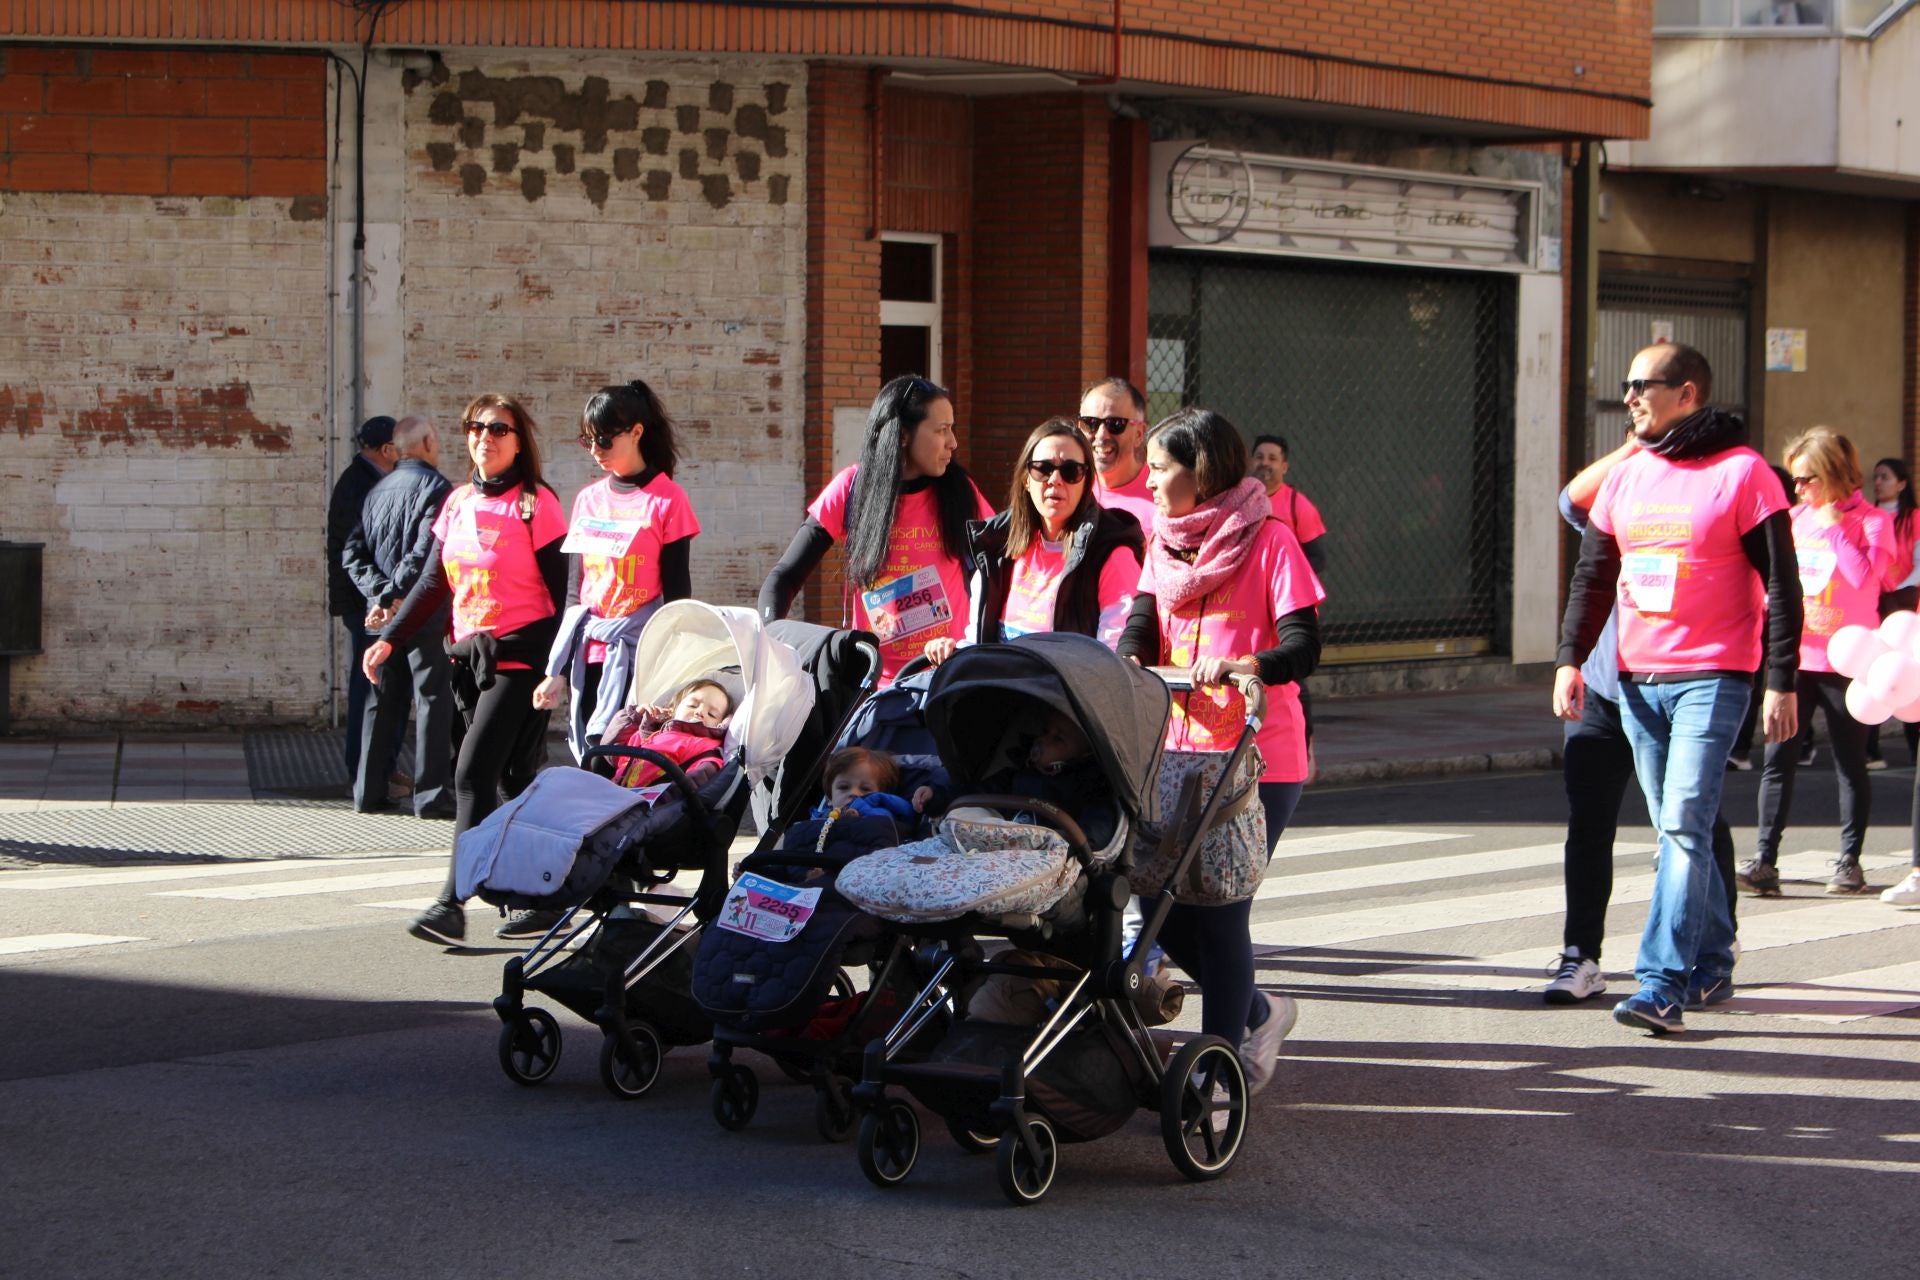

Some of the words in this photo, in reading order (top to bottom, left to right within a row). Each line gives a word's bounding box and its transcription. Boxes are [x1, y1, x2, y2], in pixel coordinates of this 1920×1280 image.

[1641, 574, 1668, 588] 2257
[895, 588, 932, 612] 2256
[758, 896, 800, 919] 2255
